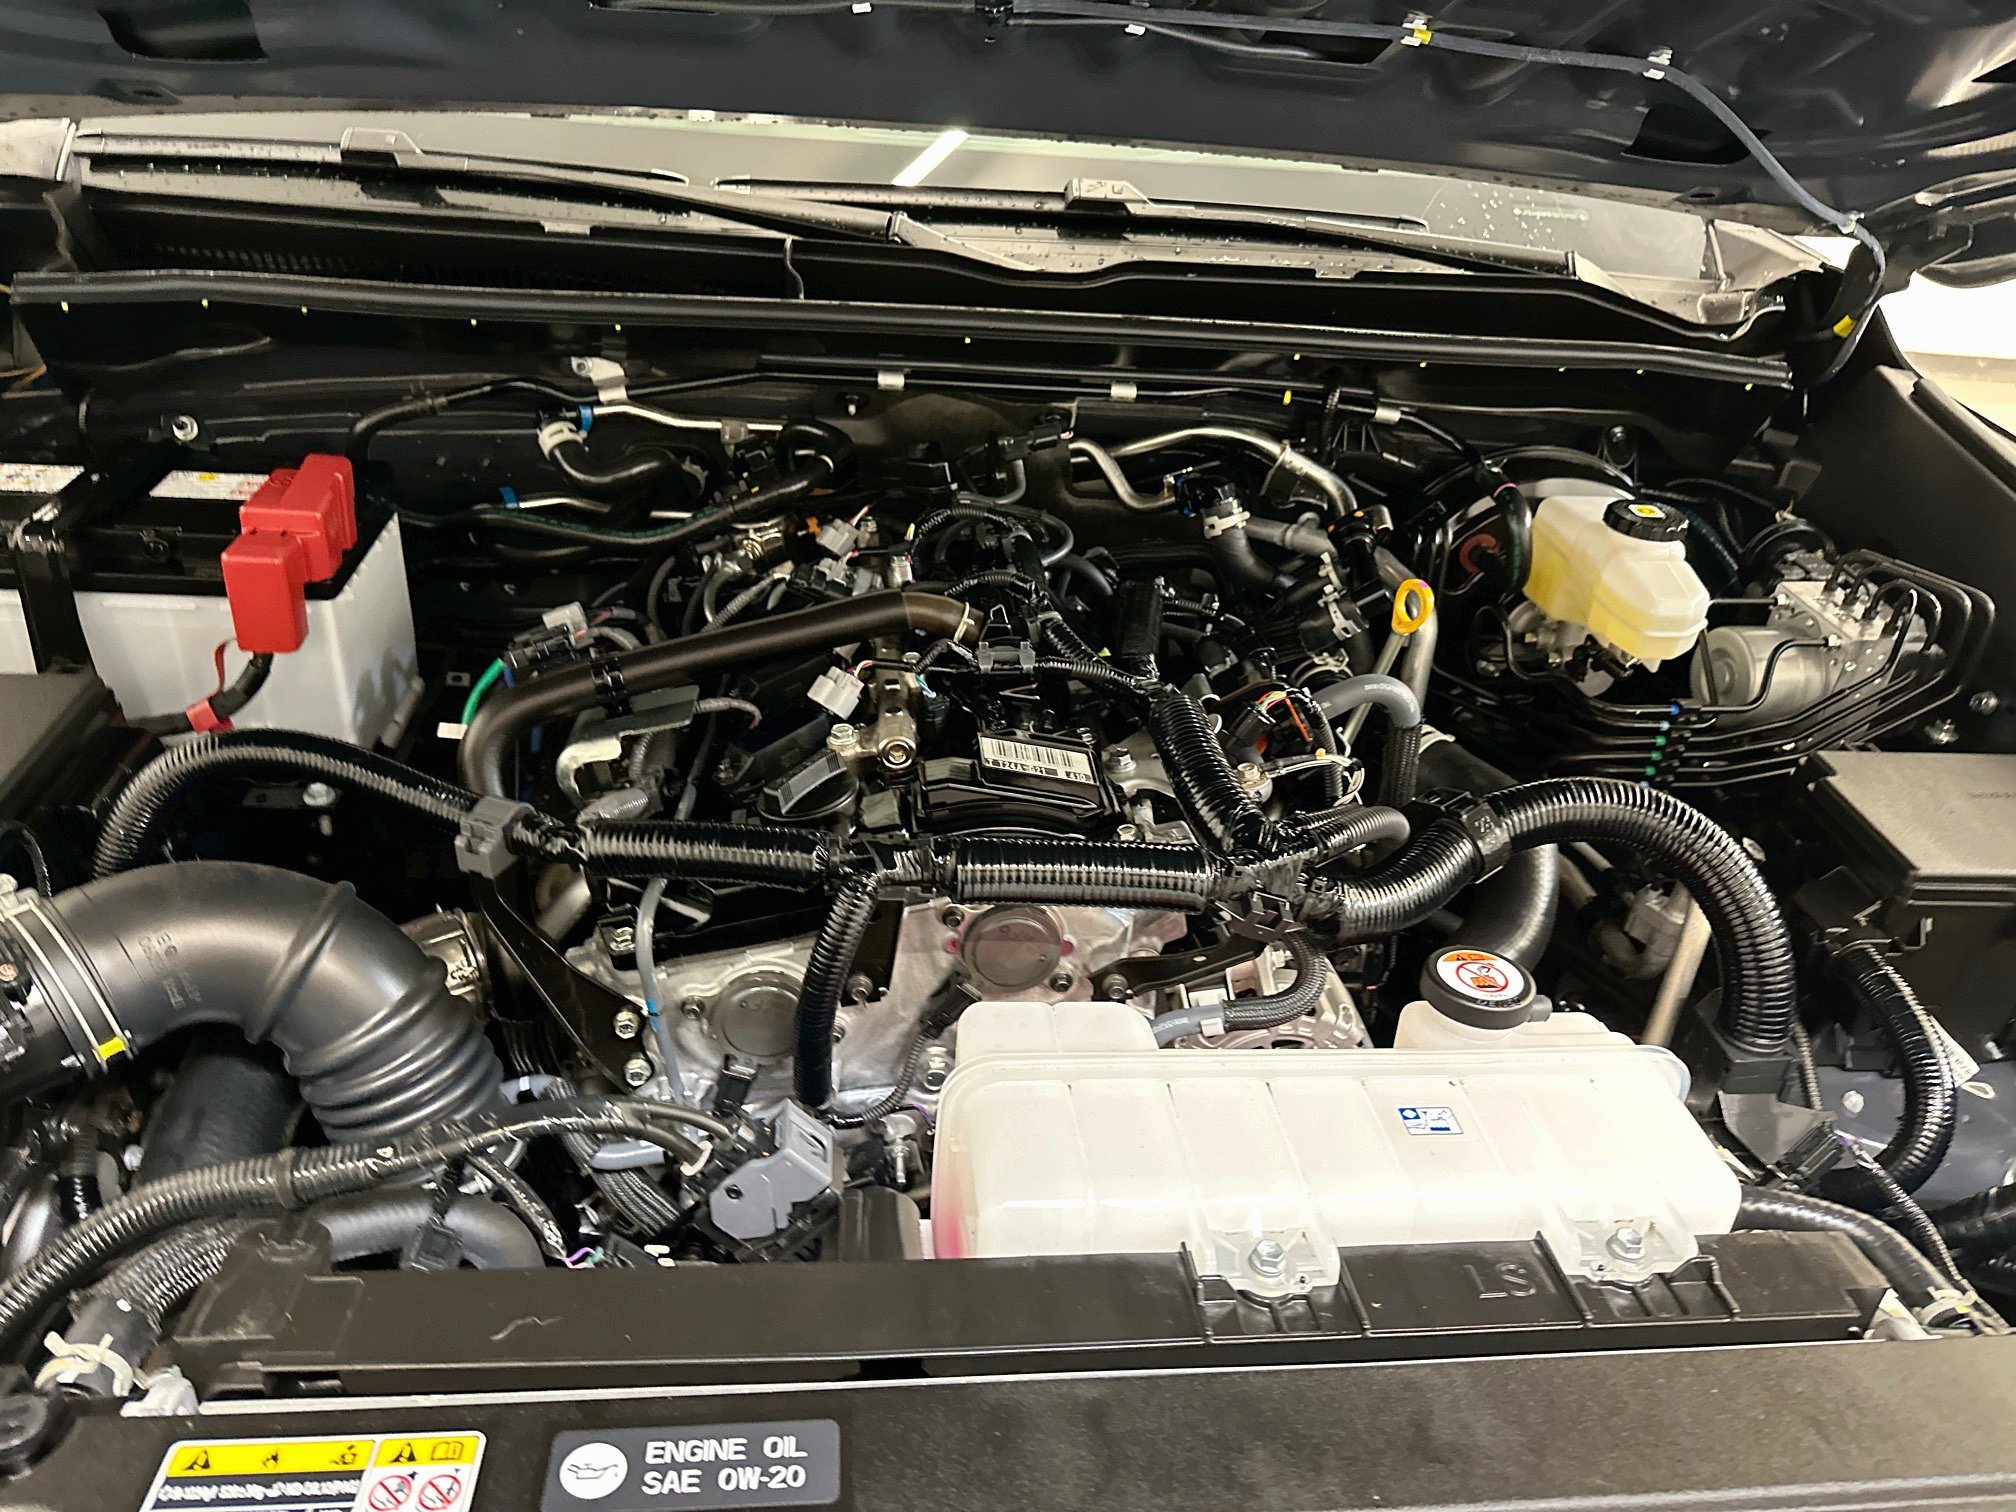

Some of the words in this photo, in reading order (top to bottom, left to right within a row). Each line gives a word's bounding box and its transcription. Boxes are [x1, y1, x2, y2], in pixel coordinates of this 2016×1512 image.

[1464, 1262, 1536, 1299] LS
[645, 1437, 748, 1464] ENGINE
[763, 1435, 808, 1459] OIL
[642, 1469, 702, 1495] SAE
[718, 1464, 807, 1491] 0W-20
